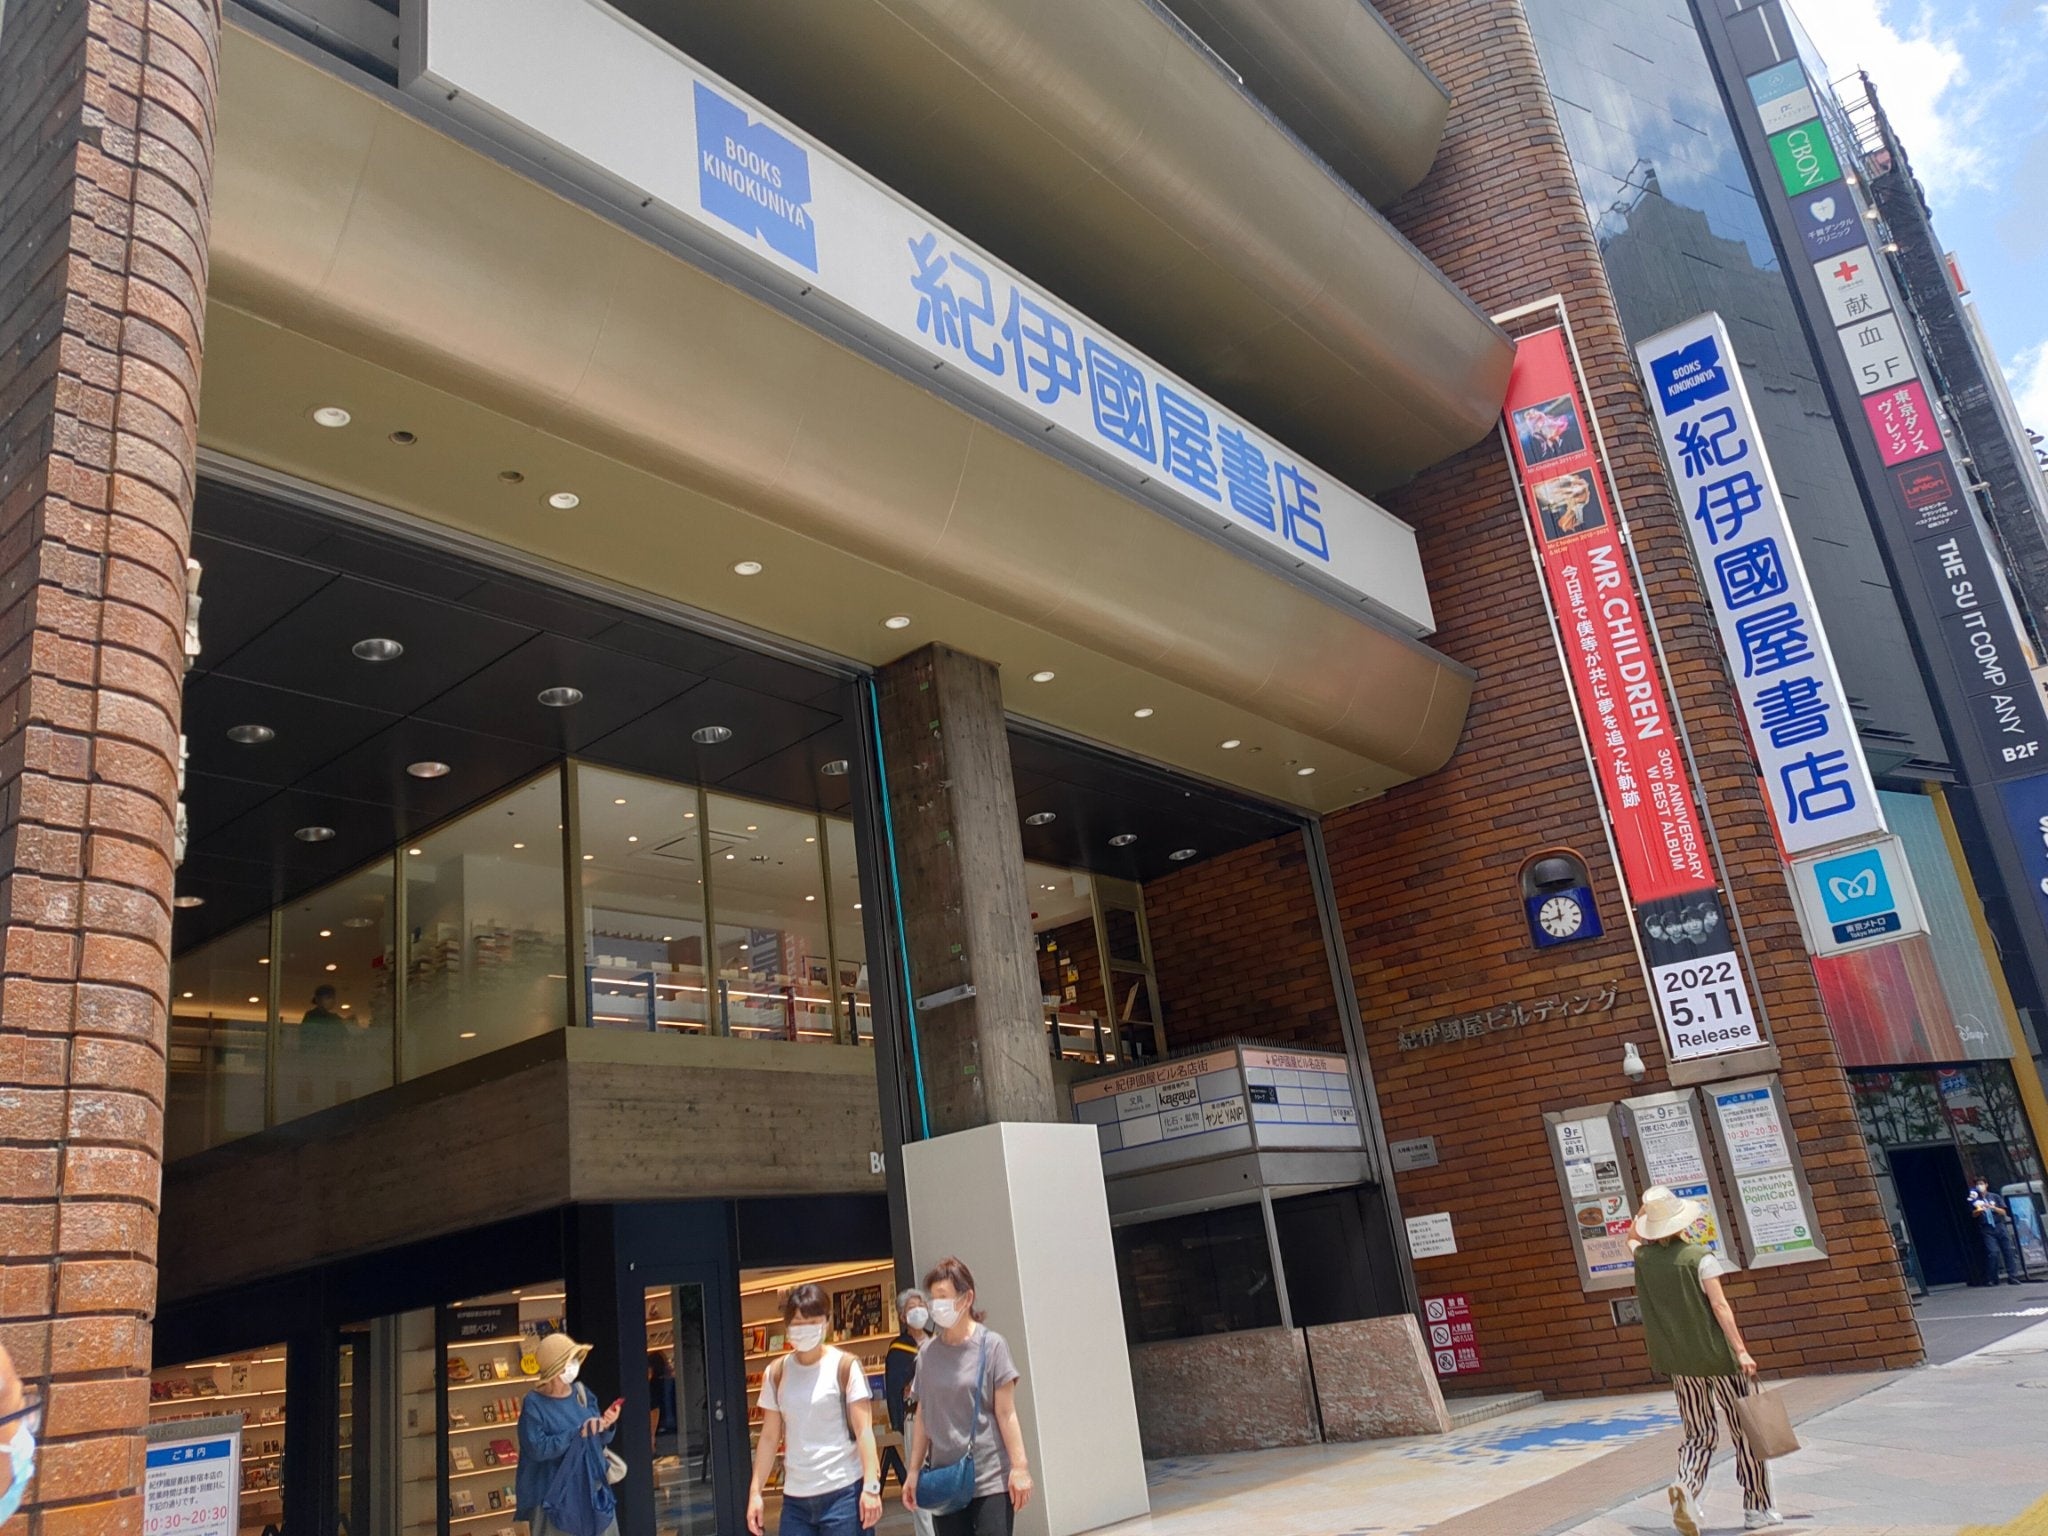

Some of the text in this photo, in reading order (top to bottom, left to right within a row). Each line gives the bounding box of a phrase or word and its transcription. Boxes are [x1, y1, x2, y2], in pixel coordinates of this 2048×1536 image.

[725, 136, 782, 189] BOOKS
[1787, 130, 1824, 188] CBON
[703, 150, 806, 230] KINOKUNIYA
[1816, 228, 1850, 245] クリニック
[1668, 369, 1715, 396] KINOKUNIYA
[1672, 360, 1701, 380] BOOKS
[908, 232, 1329, 562] 紀伊國屋書店
[1878, 399, 1907, 455] ヴィレッジ
[1894, 389, 1928, 453] 東京ダンス
[1907, 479, 1944, 495] union
[1937, 538, 1966, 580] THE
[1674, 407, 1855, 824] 紀伊國屋書店
[1562, 565, 1641, 809] 今日まで僕等が共に夢を追った軌跡
[2002, 741, 2039, 763] B2F
[1647, 766, 1685, 871] W BEST ALBUM
[1658, 748, 1705, 880] 30th ANNIVERSARY
[1846, 918, 1886, 933] 東京メトロ
[1850, 926, 1886, 939] Tokyo Metro
[1663, 961, 1735, 993] 2022
[1399, 979, 1618, 1052] 紀伊國屋ビルディング
[1670, 988, 1743, 1027] 5.11
[1677, 1024, 1752, 1048] Release
[1115, 1059, 1208, 1092] 紀伊國屋ビル名店街
[1159, 1089, 1197, 1107] kagaya
[1565, 1145, 1585, 1155] 歯科
[1743, 1180, 1793, 1194] Kinokuniya
[1745, 1188, 1795, 1204] PointCard
[172, 1447, 206, 1461] ご案内
